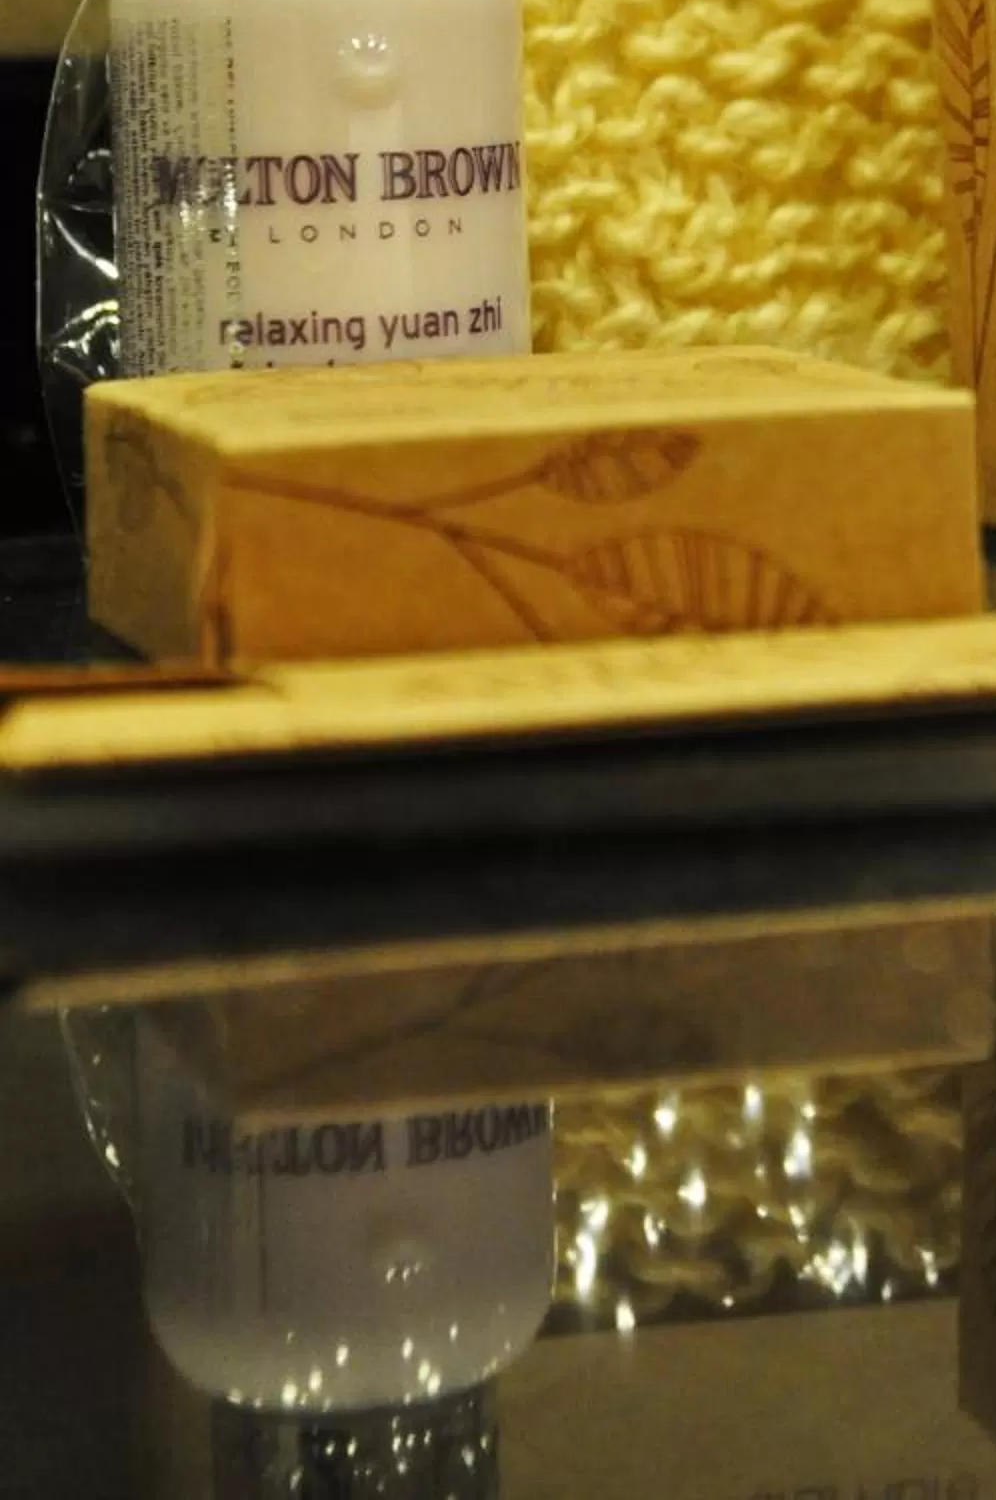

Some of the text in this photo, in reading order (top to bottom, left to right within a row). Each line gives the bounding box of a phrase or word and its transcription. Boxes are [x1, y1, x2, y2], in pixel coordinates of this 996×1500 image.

[379, 140, 521, 202] BROWN
[268, 217, 463, 244] LONDON
[219, 295, 502, 350] relaxing yuan zhi
